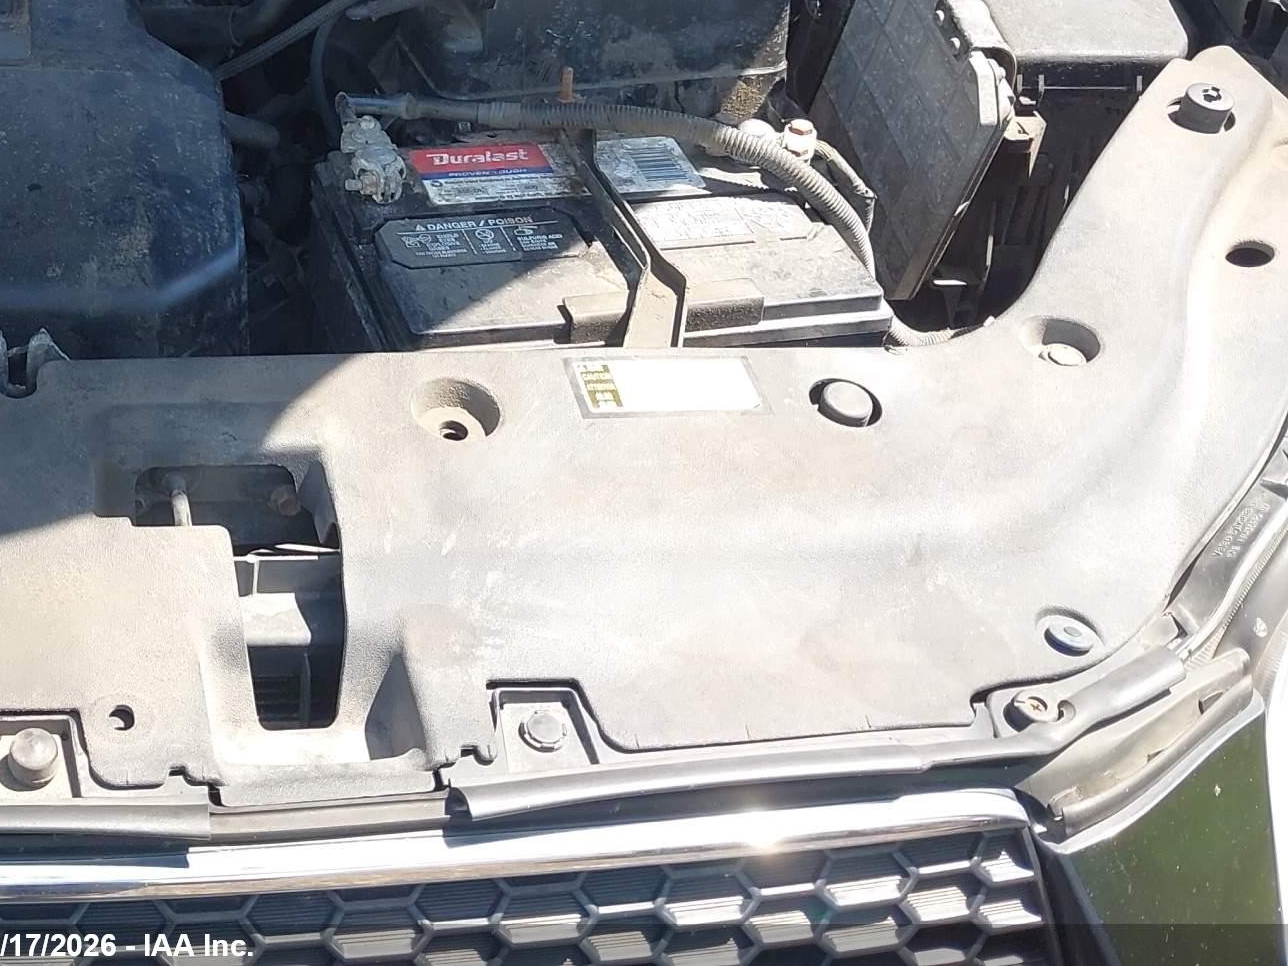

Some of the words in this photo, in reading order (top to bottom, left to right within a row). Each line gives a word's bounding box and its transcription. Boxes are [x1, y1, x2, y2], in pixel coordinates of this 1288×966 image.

[426, 149, 528, 165] Duralast
[427, 221, 476, 231] DANGER
[489, 217, 533, 226] POISON
